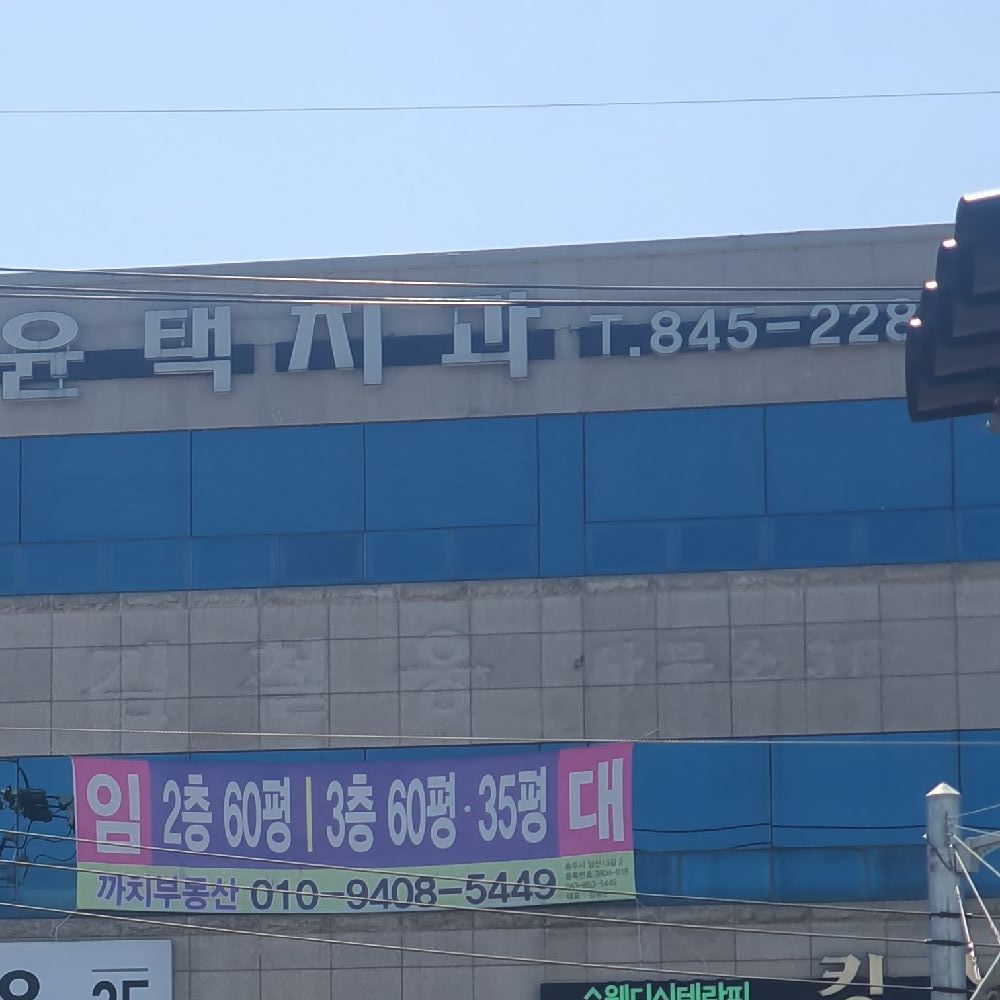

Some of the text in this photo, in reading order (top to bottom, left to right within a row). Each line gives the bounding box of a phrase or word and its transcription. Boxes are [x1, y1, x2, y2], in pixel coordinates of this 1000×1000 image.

[86, 773, 141, 855] 임
[162, 775, 213, 852] 2층
[223, 776, 291, 853] 60평
[326, 774, 377, 852] 3층
[568, 758, 625, 842] 대
[96, 868, 557, 912] 까치부동산 010-9408-5449
